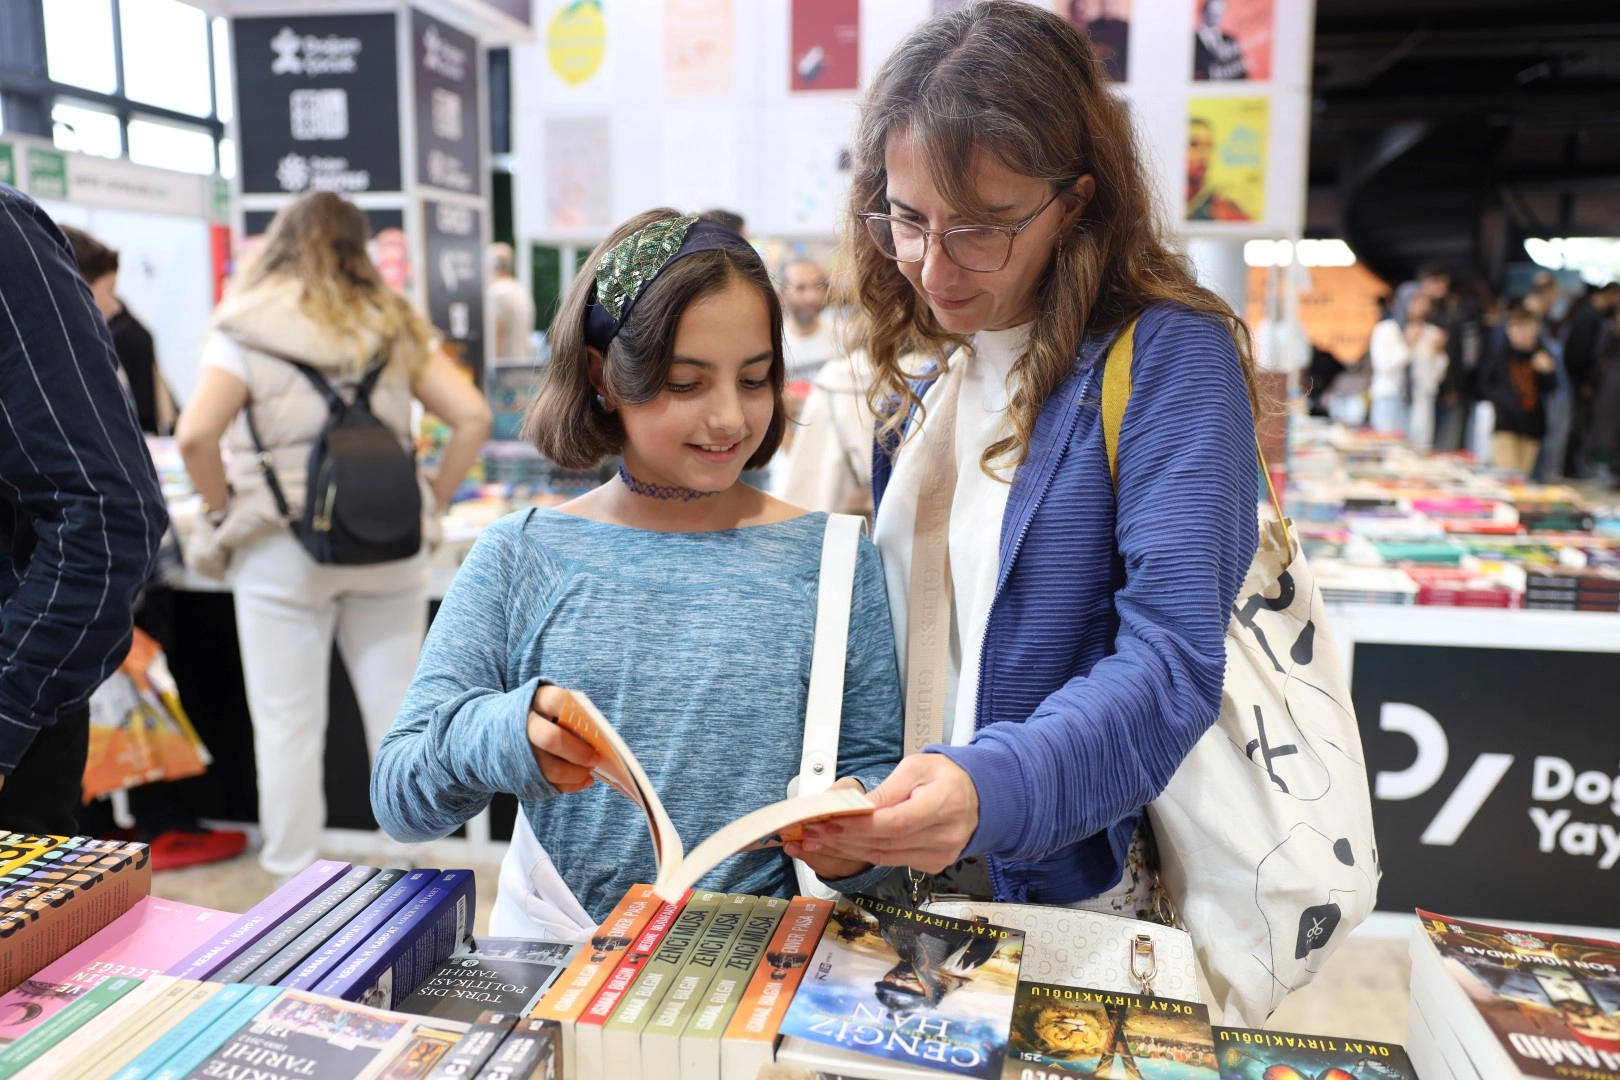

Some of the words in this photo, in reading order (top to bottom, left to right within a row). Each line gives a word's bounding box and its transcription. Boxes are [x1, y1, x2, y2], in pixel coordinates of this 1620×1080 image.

[920, 569, 940, 648] GUESS
[1531, 755, 1620, 818] Do
[672, 910, 709, 937] MUSA
[855, 896, 959, 931] TİRYAKİOĞLU
[607, 918, 635, 938] ENVER
[706, 913, 743, 939] MUSA
[740, 916, 776, 943] MUSA
[963, 925, 1010, 940] OKAY
[191, 945, 226, 967] KEMAL
[230, 915, 265, 940] KARPAT
[232, 952, 262, 975] KEMAL
[265, 925, 296, 948] KARPAT
[261, 957, 293, 977] KEMAL
[294, 929, 325, 950] KARPAT
[297, 955, 329, 977] KEMAL
[331, 924, 365, 947] KARPAT
[336, 954, 370, 980] KEMAL
[369, 925, 401, 949] KARPAT
[781, 933, 805, 954] ENVER
[1461, 945, 1571, 968] HÜKÜMDAR
[1573, 959, 1617, 973] SON
[428, 977, 529, 994] POLİTİKASI
[437, 968, 499, 979] TARİHİ
[54, 982, 83, 995] VE
[417, 986, 451, 997] DIŞ
[450, 990, 503, 1003] TÜRK
[1031, 986, 1143, 1009] TİRYAKİOĞLU
[1150, 1000, 1193, 1015] OKAY
[851, 1002, 953, 1038] HAN
[807, 1013, 981, 1068] CENGİZ
[1220, 1031, 1337, 1052] TİRYAKİOĞLU
[1344, 1042, 1390, 1057] OKAY
[222, 1042, 318, 1076] TARİHİ
